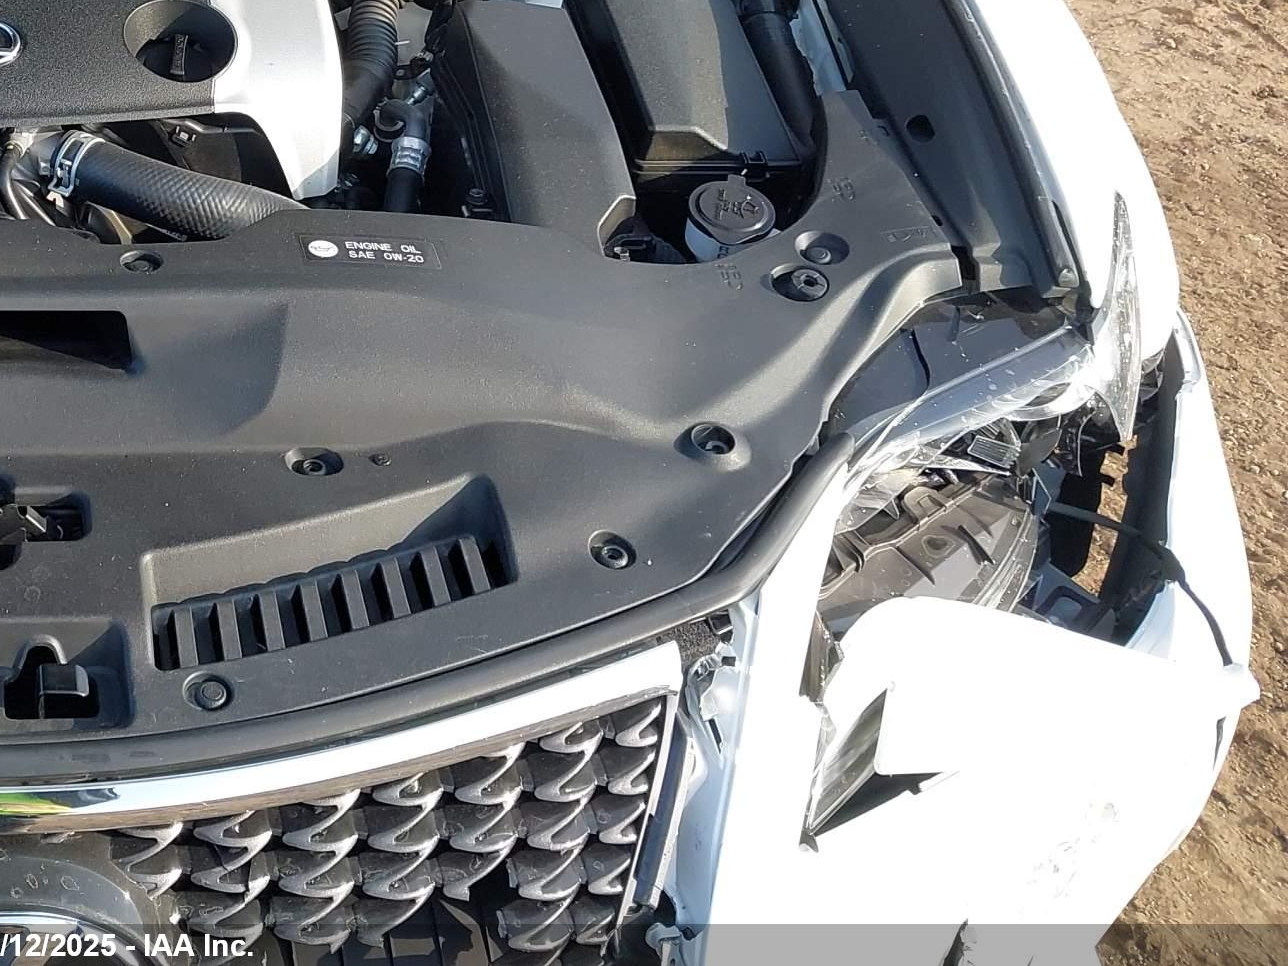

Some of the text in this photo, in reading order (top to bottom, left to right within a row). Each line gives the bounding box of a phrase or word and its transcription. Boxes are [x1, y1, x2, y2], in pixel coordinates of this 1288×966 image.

[344, 241, 423, 253] ENGINE OIL
[348, 250, 377, 260] SAE
